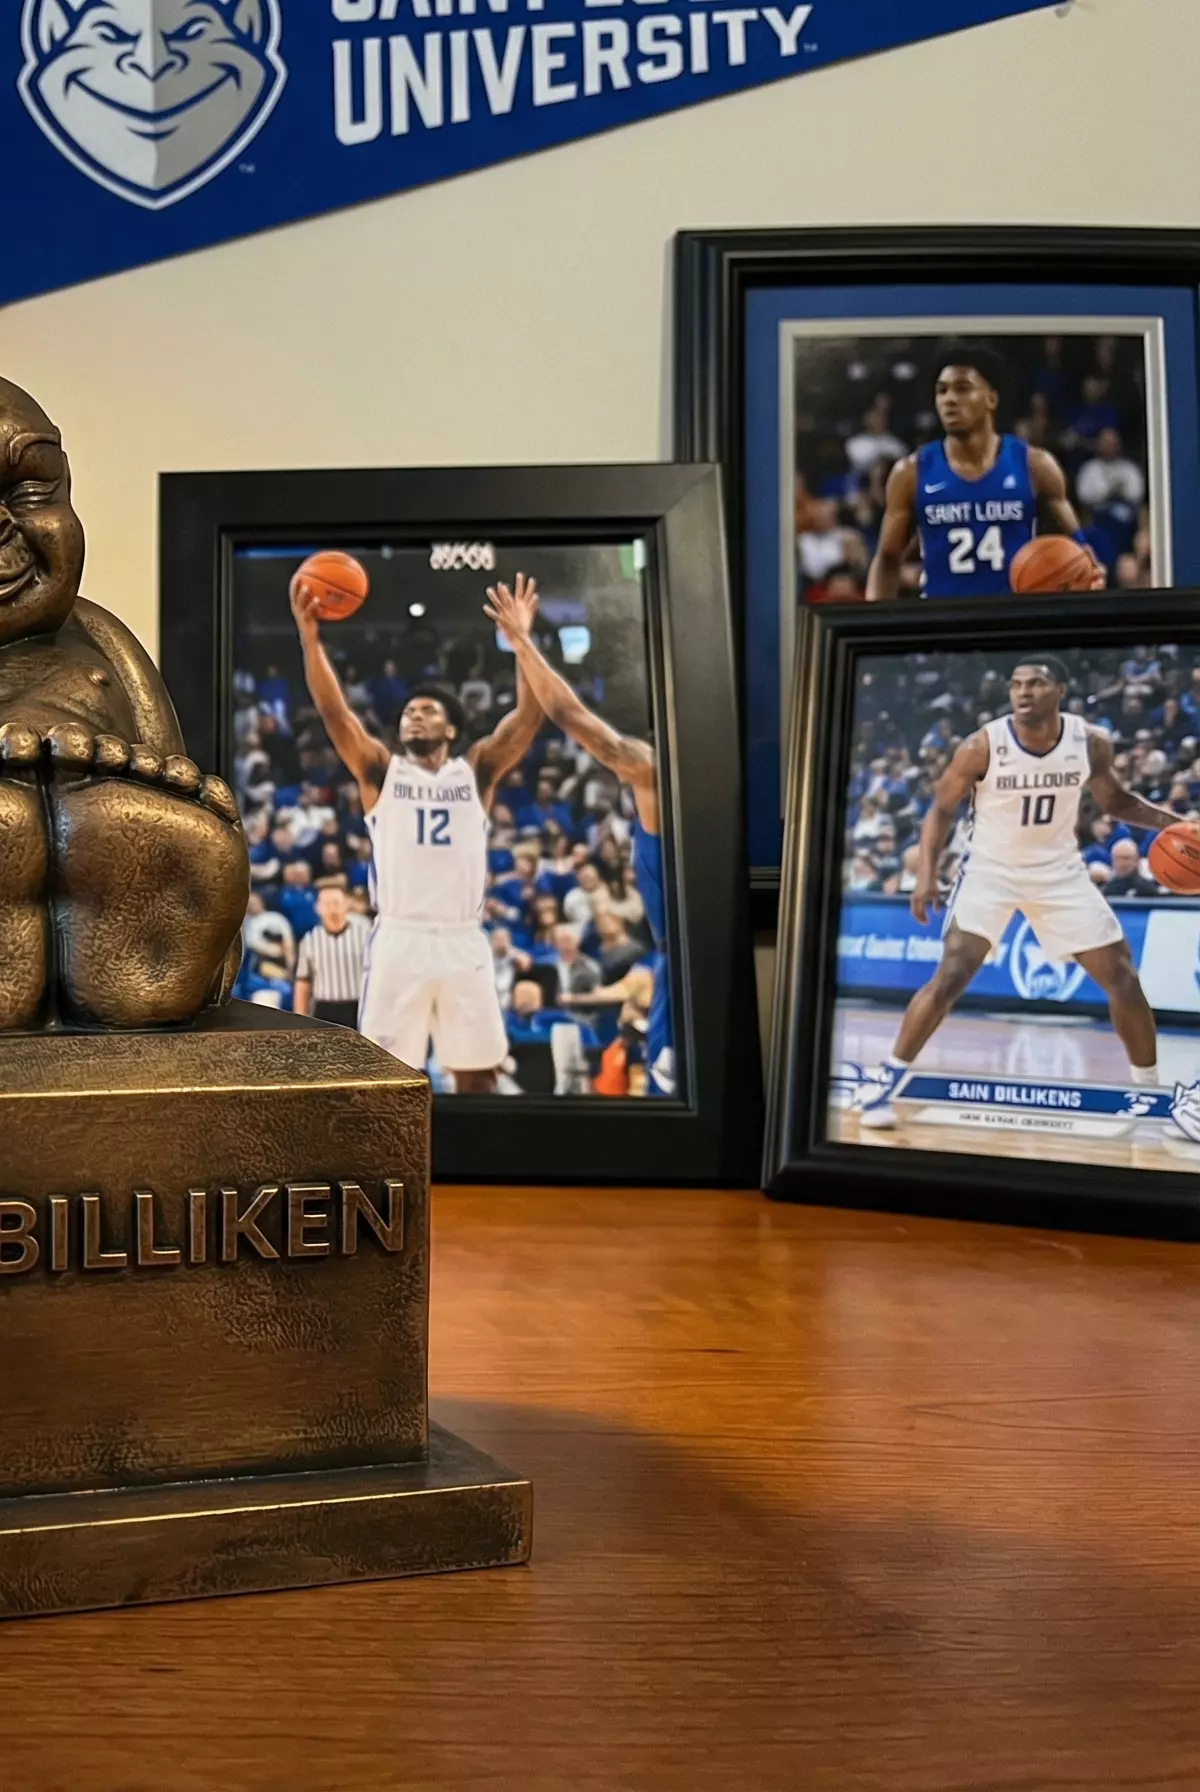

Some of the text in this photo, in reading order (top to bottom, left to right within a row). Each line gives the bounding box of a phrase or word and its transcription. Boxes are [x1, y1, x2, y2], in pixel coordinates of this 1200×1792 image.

[331, 4, 813, 146] UNIVERSITY
[947, 525, 1005, 574] 24
[415, 808, 451, 845] 12
[1021, 794, 1056, 826] 10
